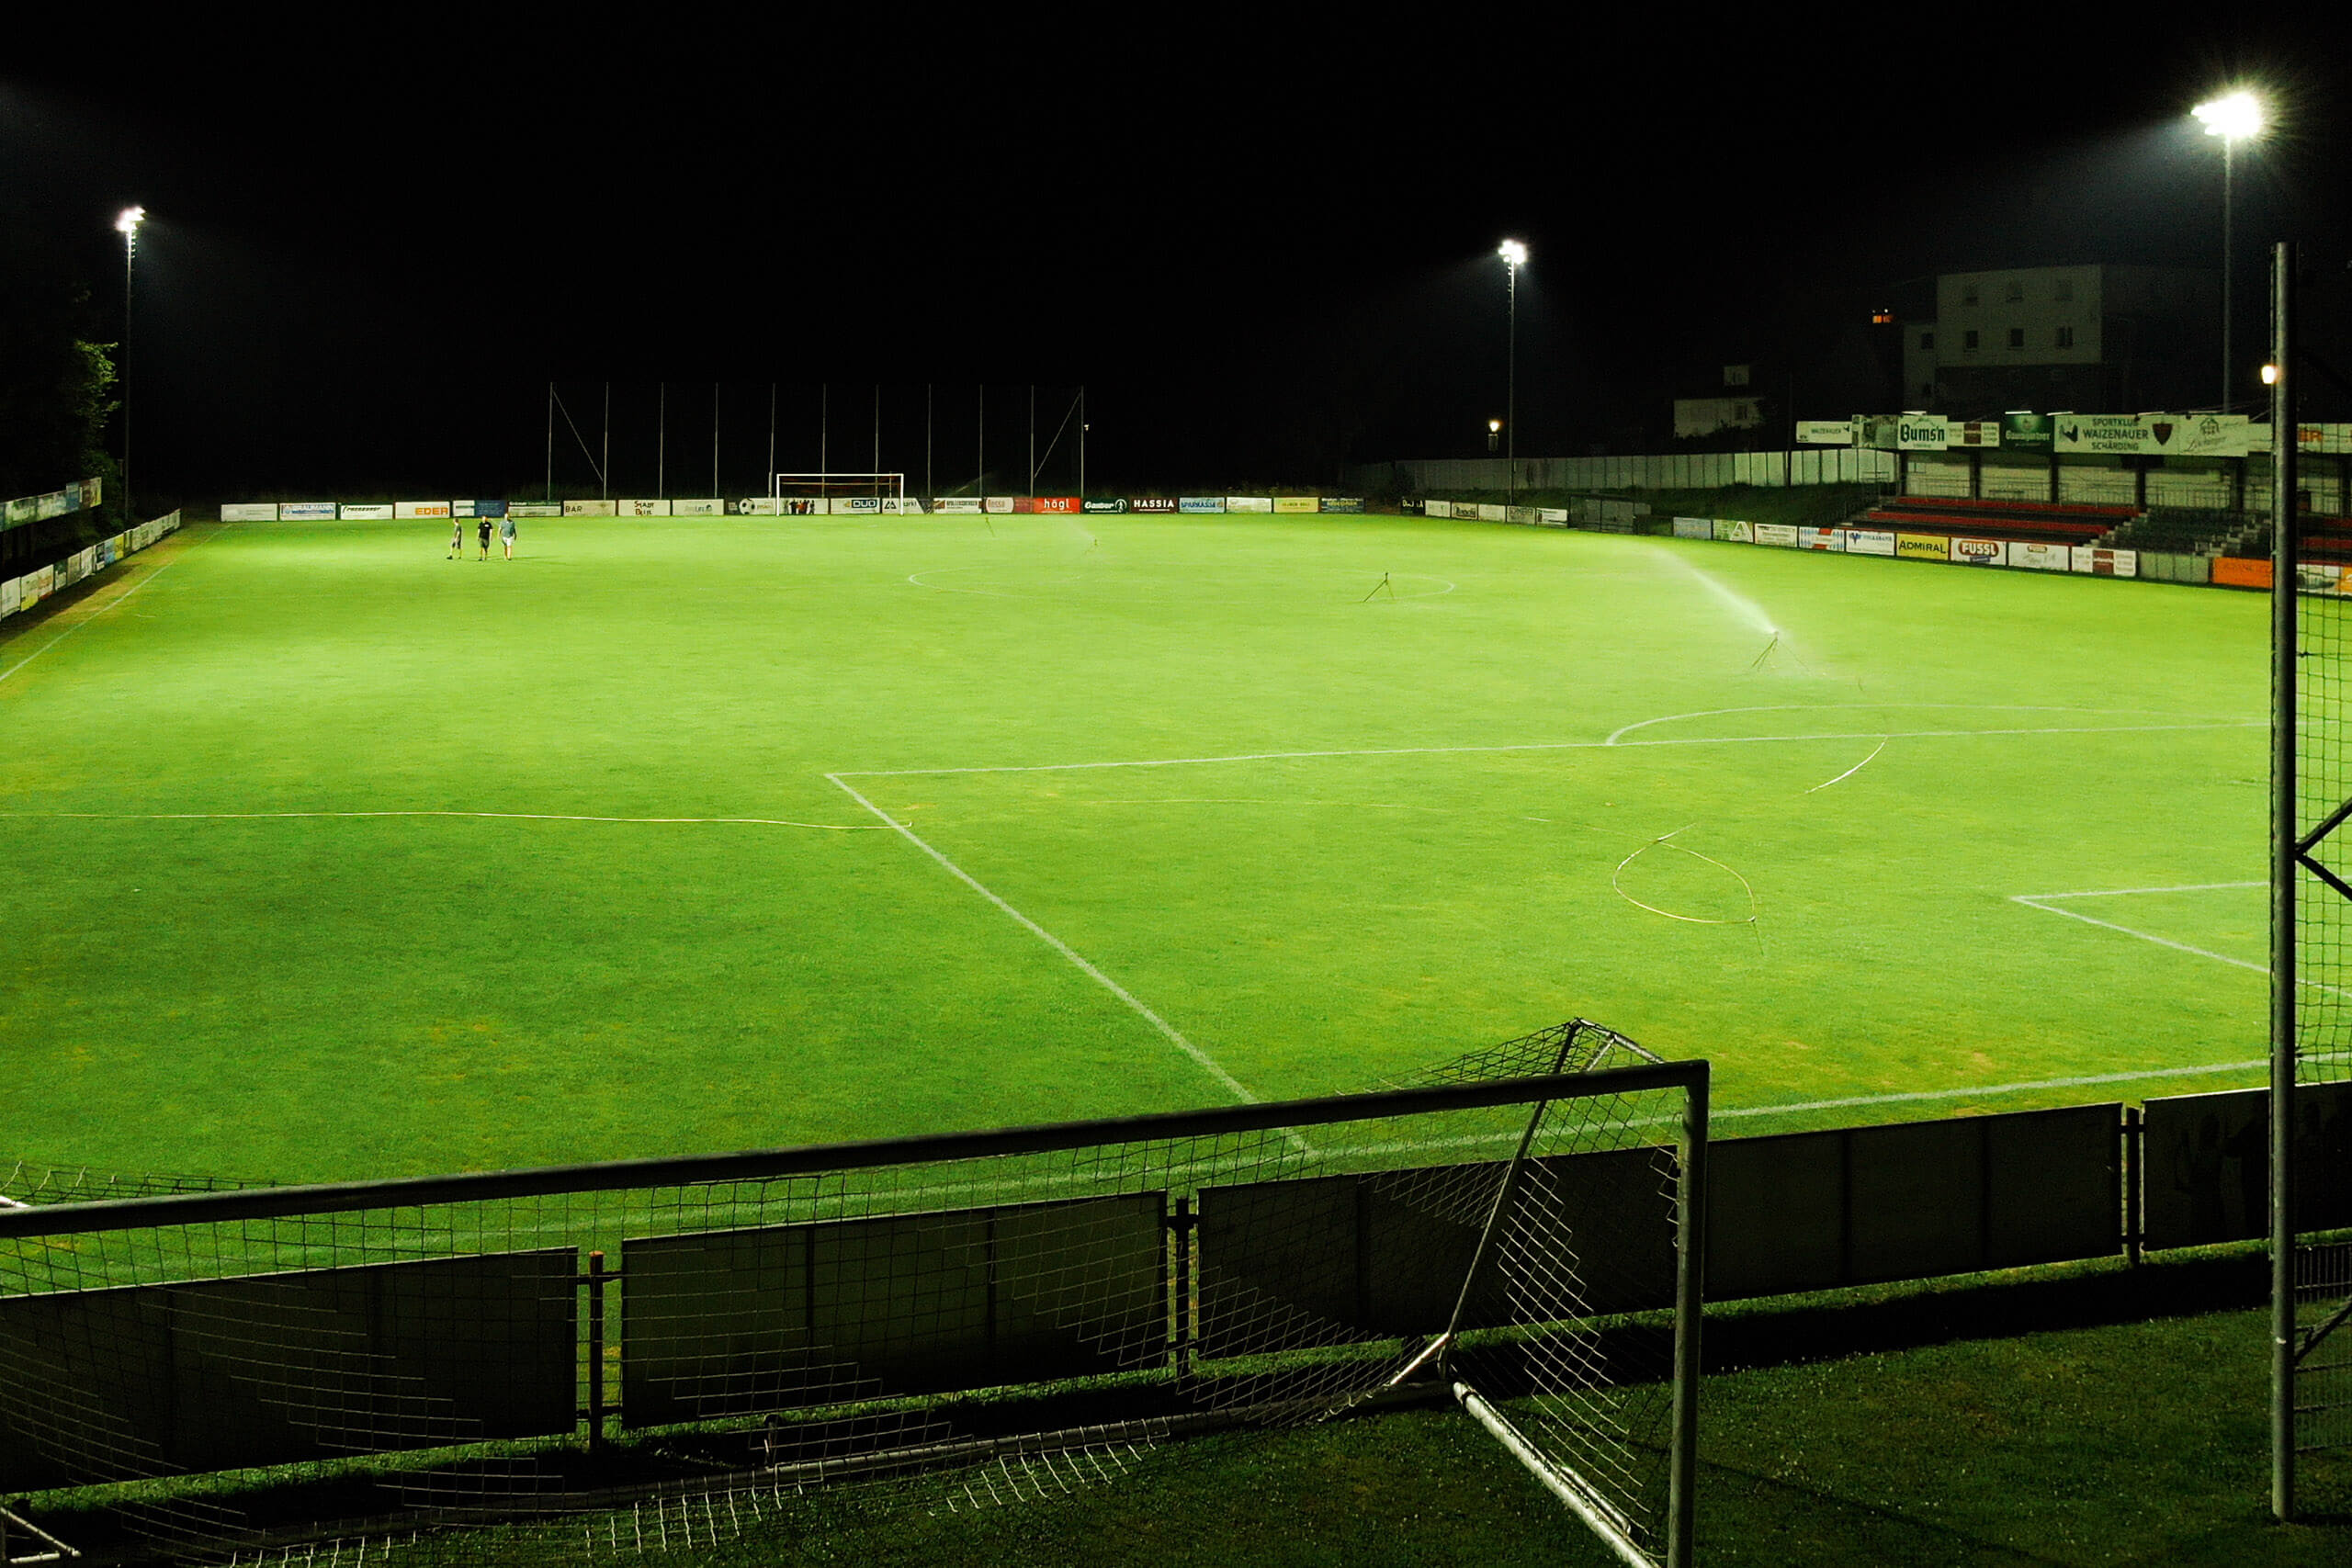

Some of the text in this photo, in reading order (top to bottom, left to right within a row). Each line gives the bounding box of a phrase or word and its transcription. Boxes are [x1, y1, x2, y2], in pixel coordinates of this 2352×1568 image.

[2083, 429, 2148, 439] WAIZENAUER
[854, 500, 876, 508] DUO
[1134, 500, 1174, 508] HASSIA
[415, 507, 448, 515] EDER
[565, 505, 582, 513] BAR
[1898, 540, 1946, 554] ADMIRAL
[1962, 542, 1996, 555] FUSSL
